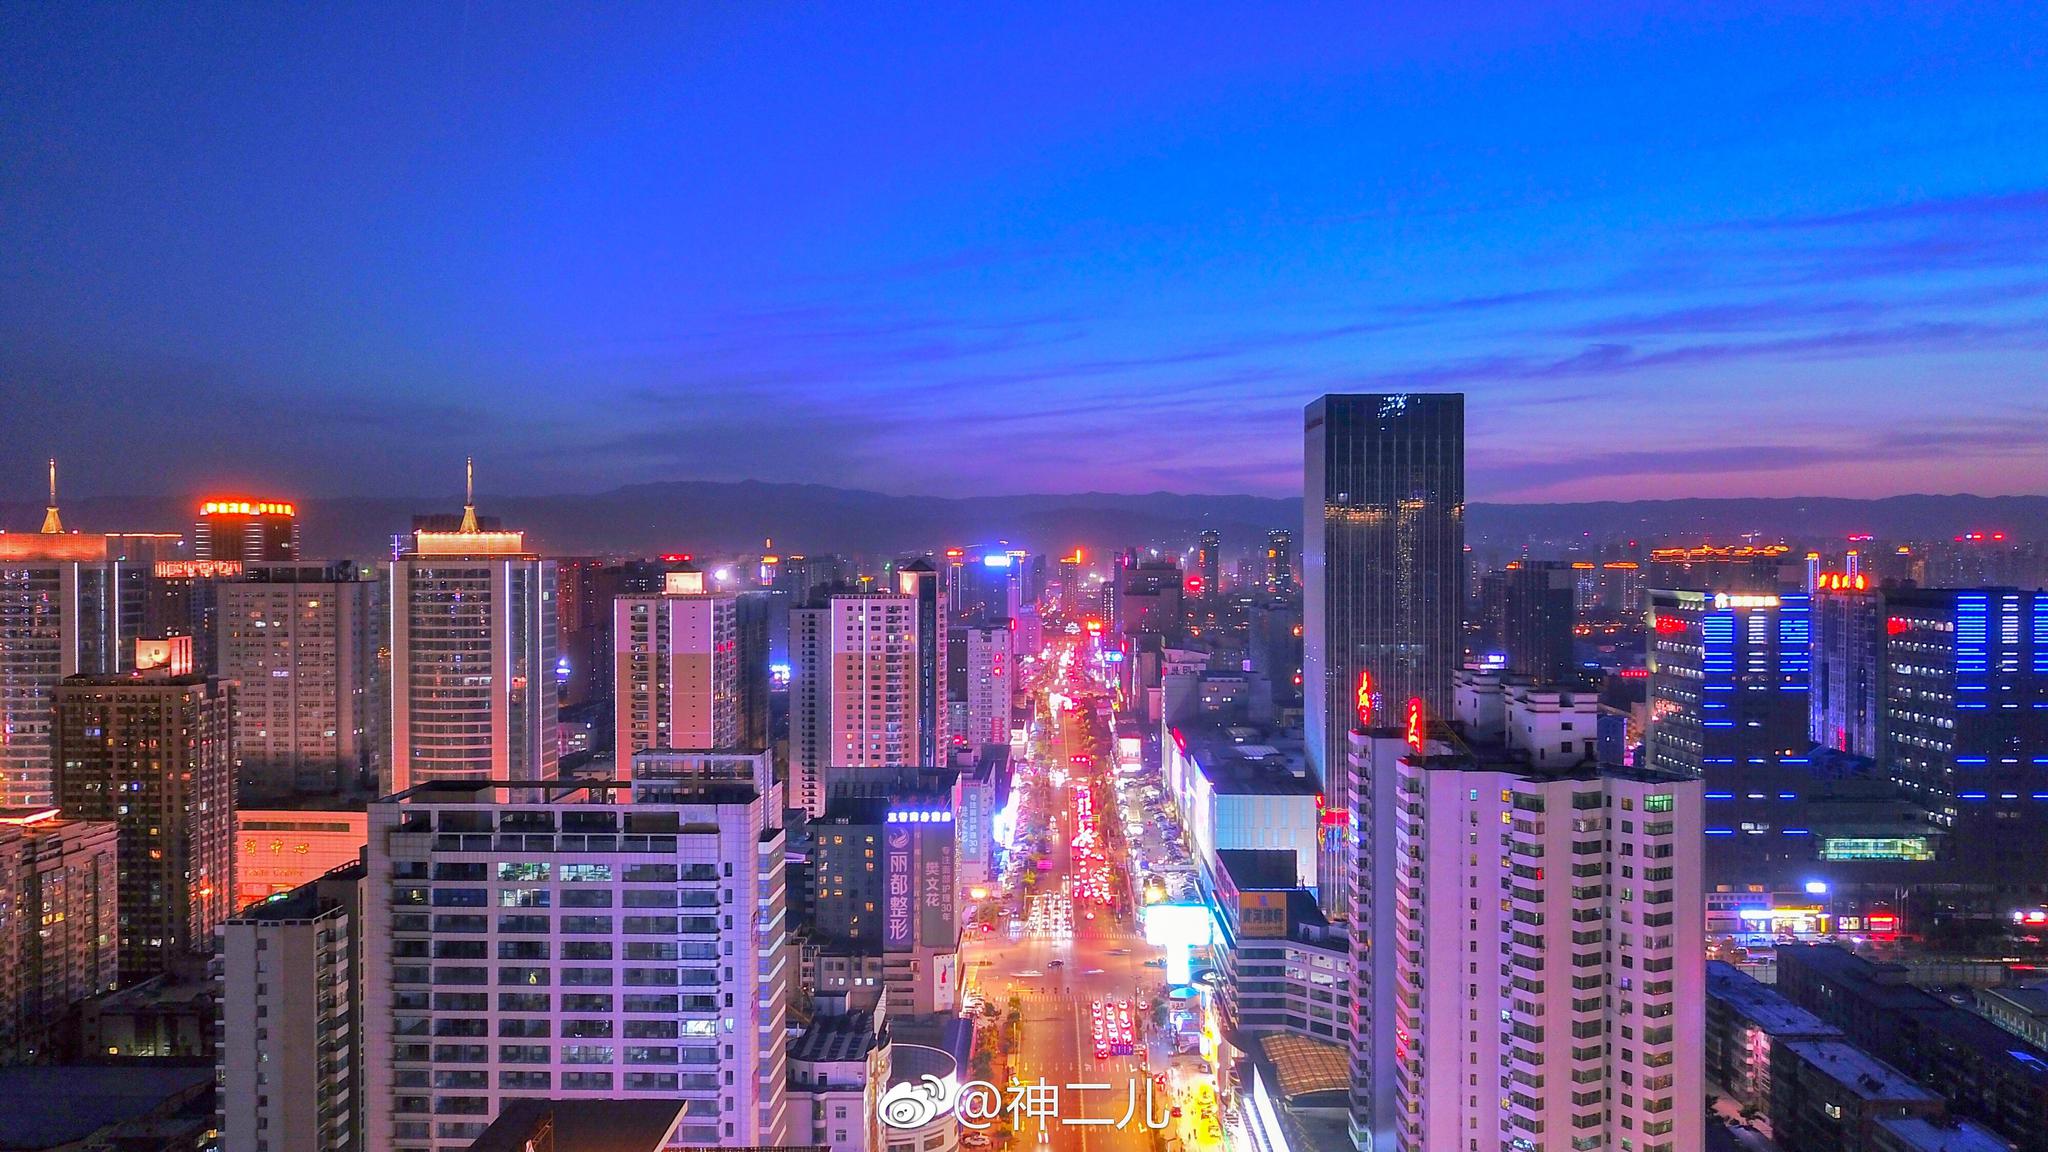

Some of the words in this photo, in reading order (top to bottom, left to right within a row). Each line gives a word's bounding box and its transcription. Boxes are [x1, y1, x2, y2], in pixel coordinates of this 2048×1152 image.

[889, 851, 909, 940] 丽都整形
[925, 862, 940, 907] 樊文花
